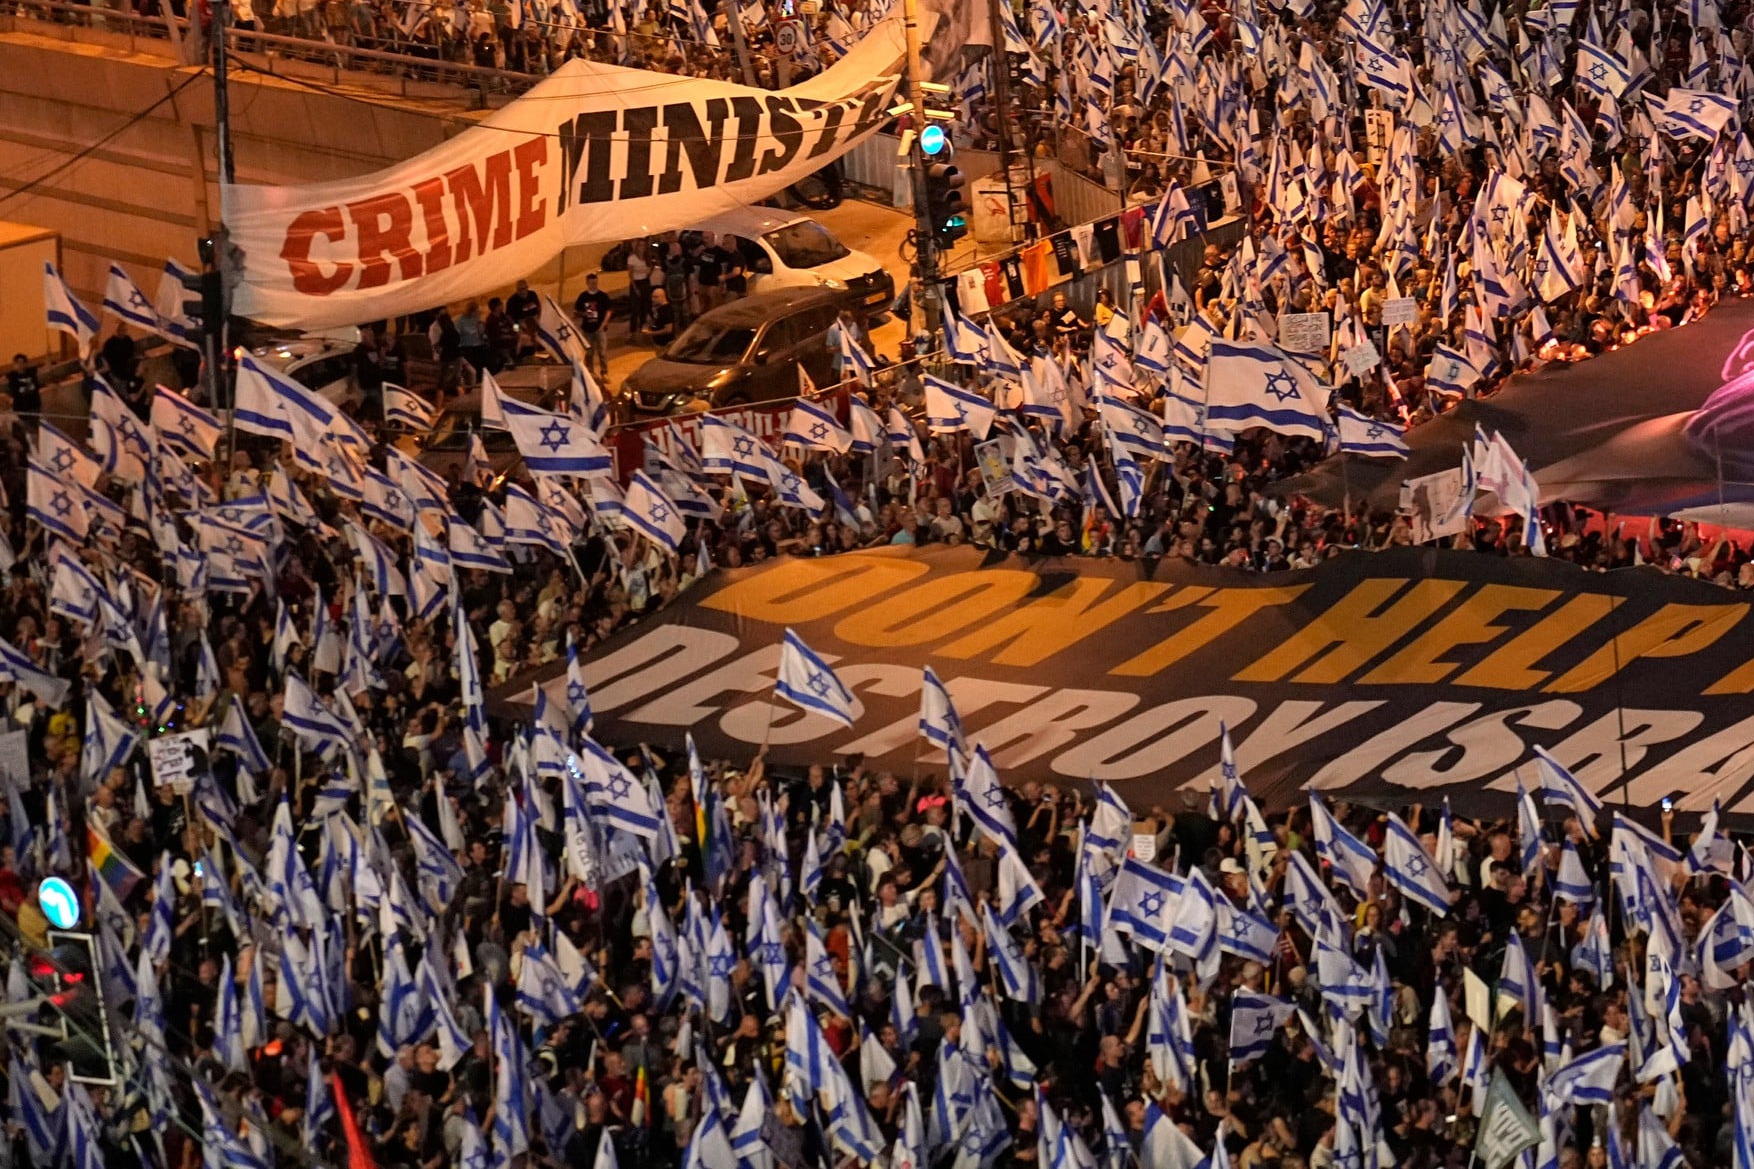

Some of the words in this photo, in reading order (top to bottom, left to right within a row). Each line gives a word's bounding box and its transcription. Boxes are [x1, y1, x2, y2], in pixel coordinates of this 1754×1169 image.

[780, 33, 792, 46] 30
[280, 136, 547, 296] CRIME
[558, 77, 893, 217] MINISTE
[697, 553, 1316, 678] DON'T
[1231, 577, 1751, 693] HELP
[506, 624, 1388, 792] DESTROY
